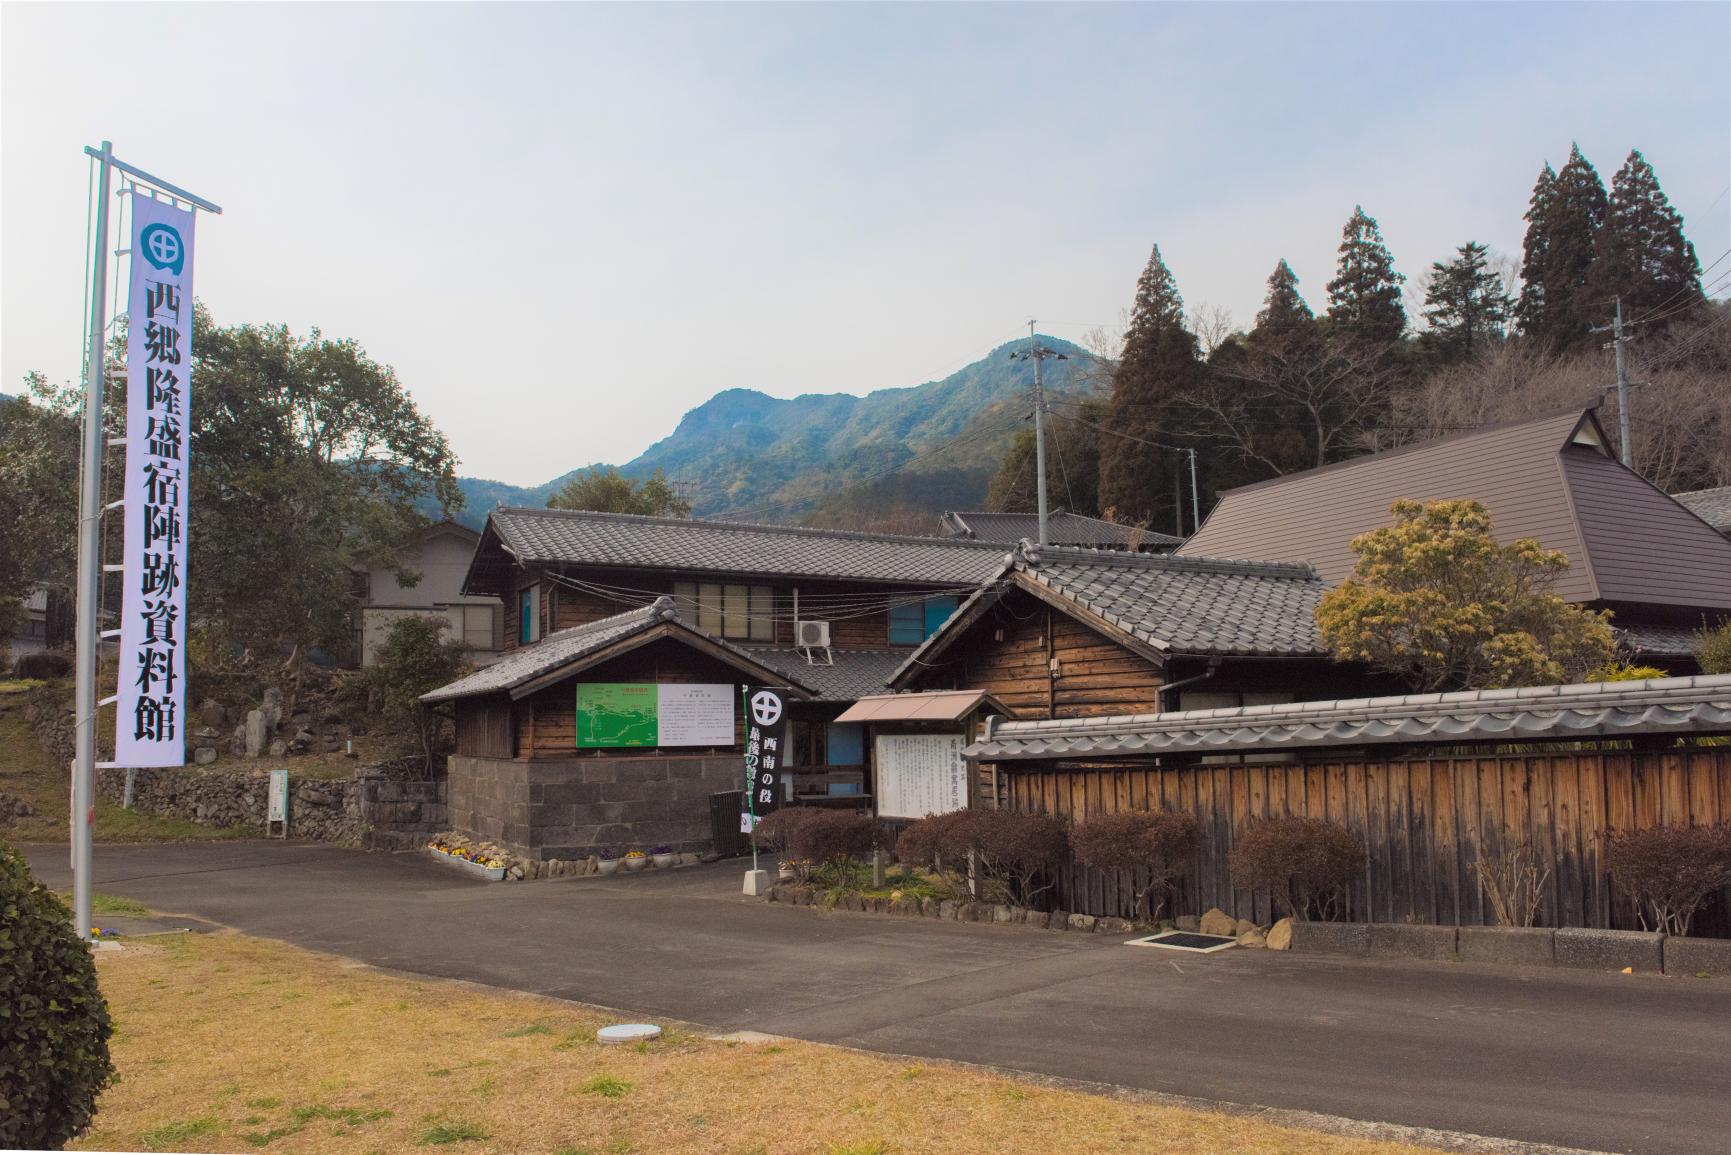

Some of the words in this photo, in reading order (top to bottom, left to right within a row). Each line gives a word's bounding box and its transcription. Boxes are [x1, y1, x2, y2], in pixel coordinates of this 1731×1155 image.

[134, 278, 182, 742] 西郷隆盛宿陣跡資料館
[759, 737, 777, 803] 西南の役
